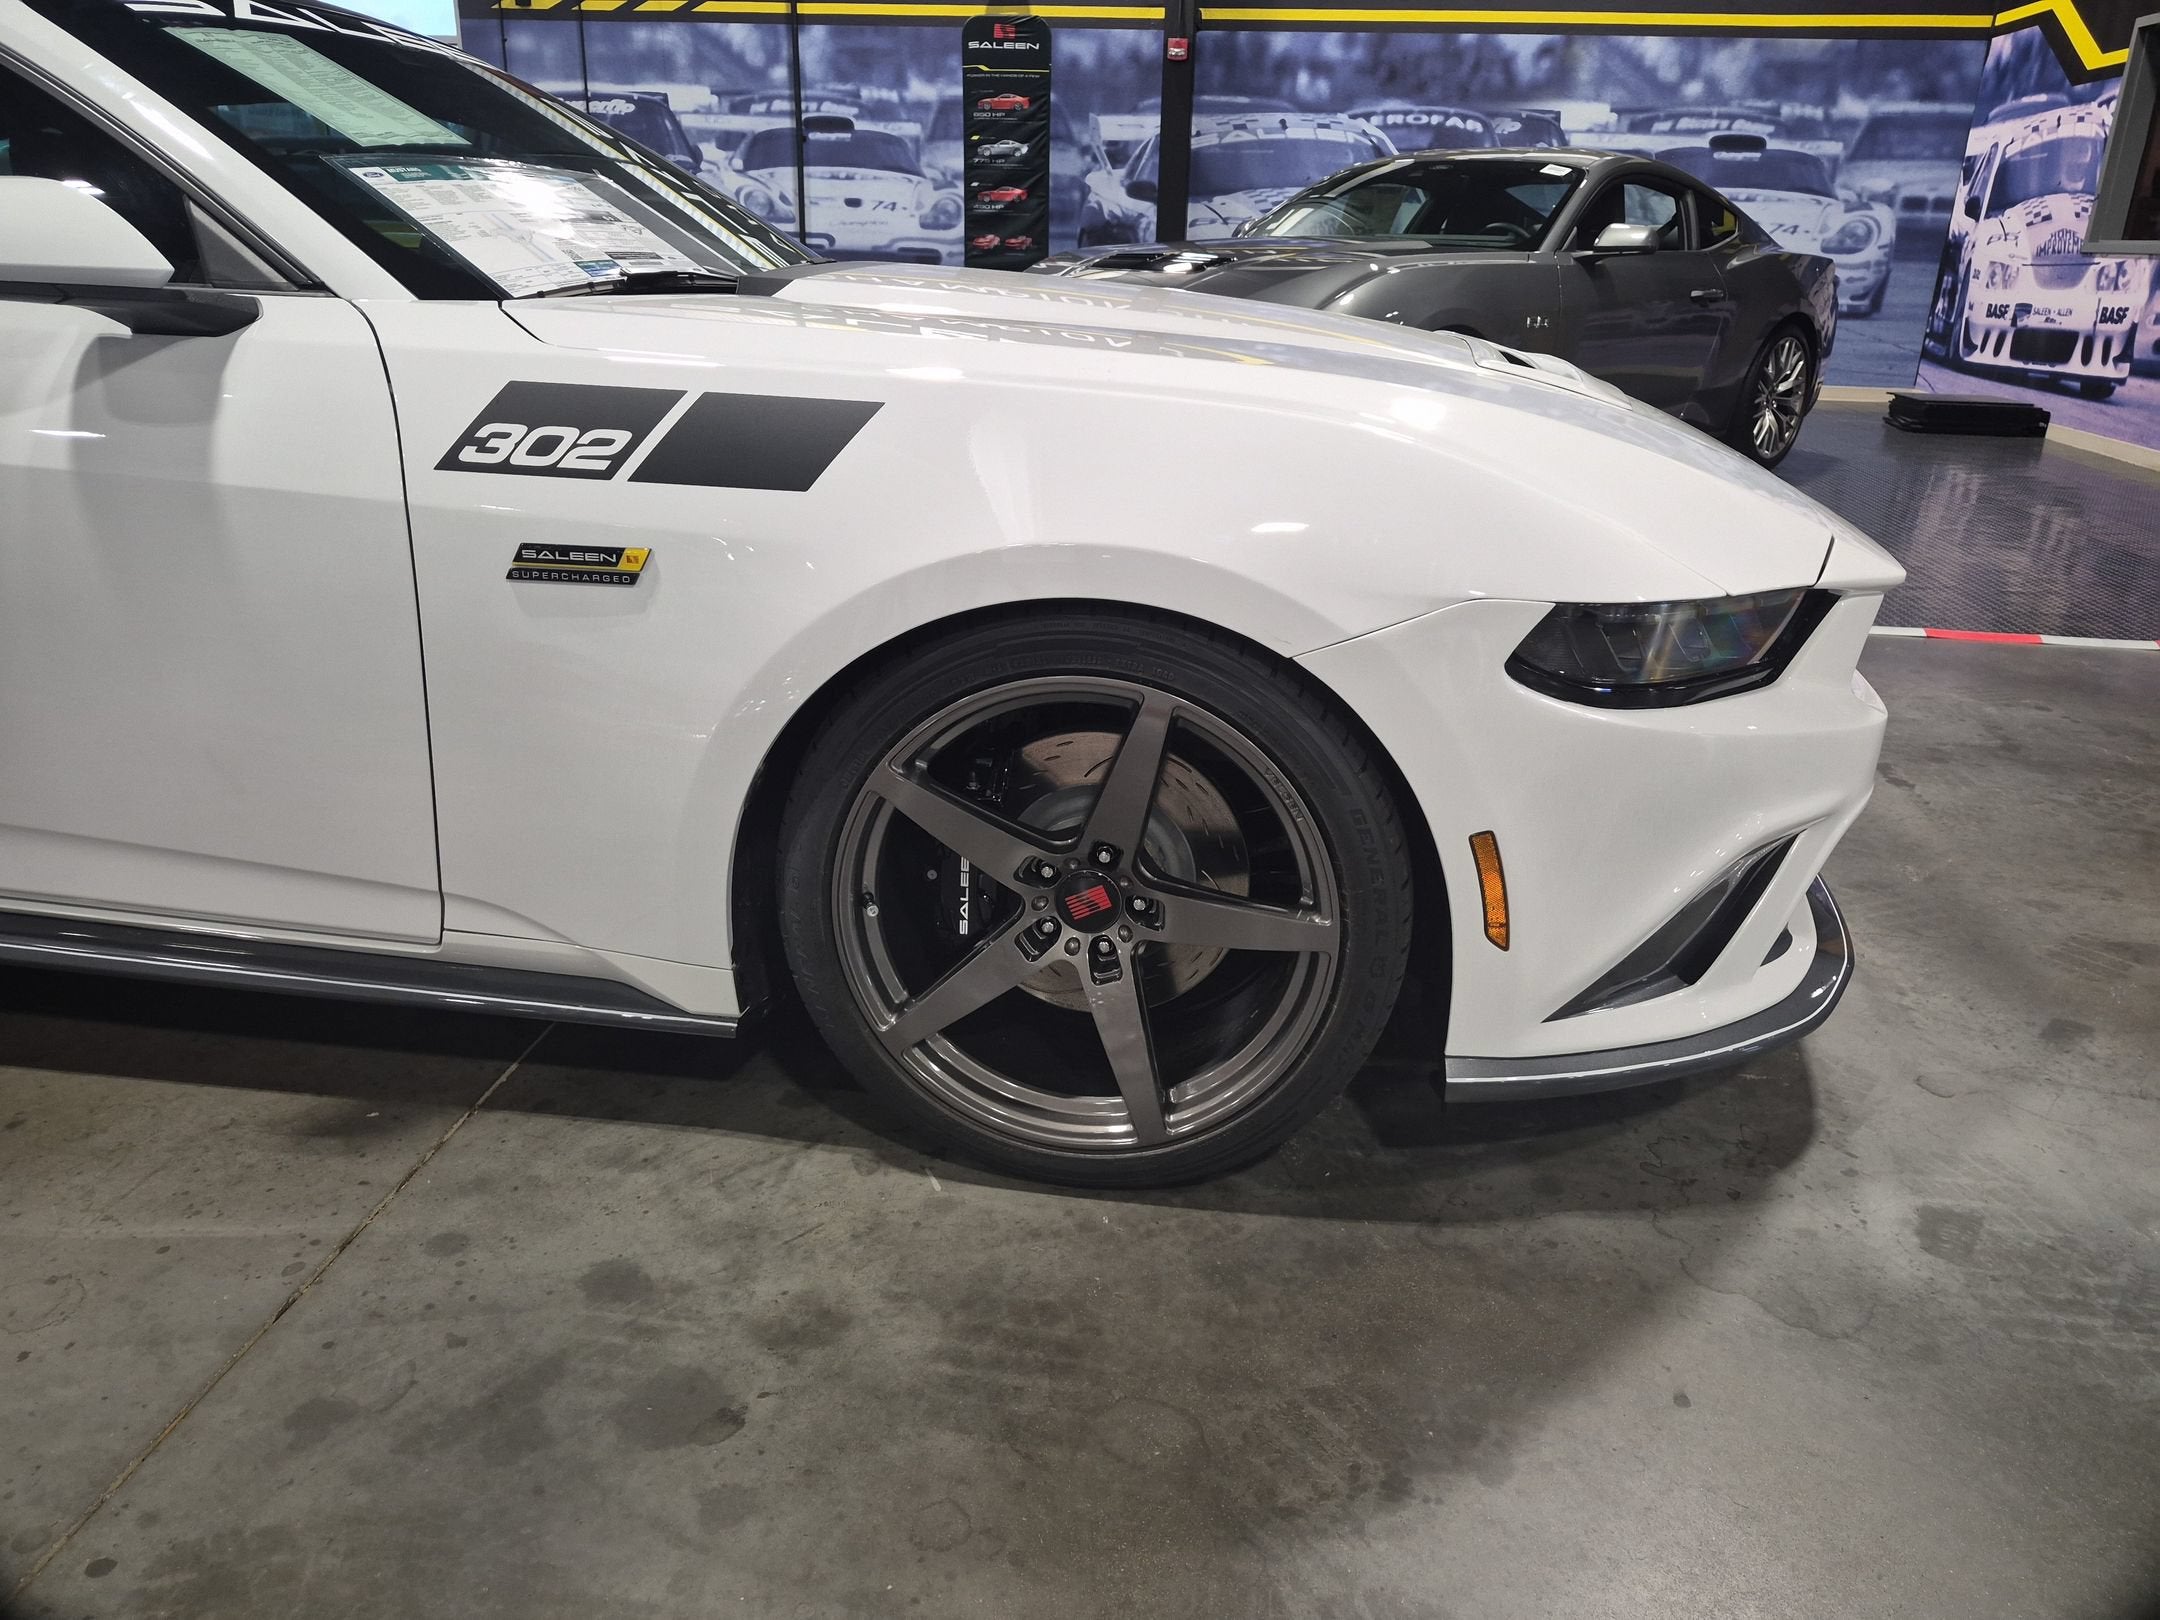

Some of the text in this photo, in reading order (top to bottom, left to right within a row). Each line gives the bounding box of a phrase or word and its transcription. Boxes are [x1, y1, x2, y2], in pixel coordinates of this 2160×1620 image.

[968, 41, 1040, 50] SALEEN
[871, 200, 897, 212] 74
[1768, 222, 1800, 236] 74
[2036, 239, 2084, 257] IMPROVEM
[1986, 303, 2010, 320] BASF
[2098, 306, 2130, 325] BASF
[458, 422, 633, 471] 302
[521, 548, 617, 563] SALEEN
[511, 570, 632, 584] SUPERCHARGED
[1351, 807, 1389, 948] GENERAL
[959, 855, 971, 935] SALEE
